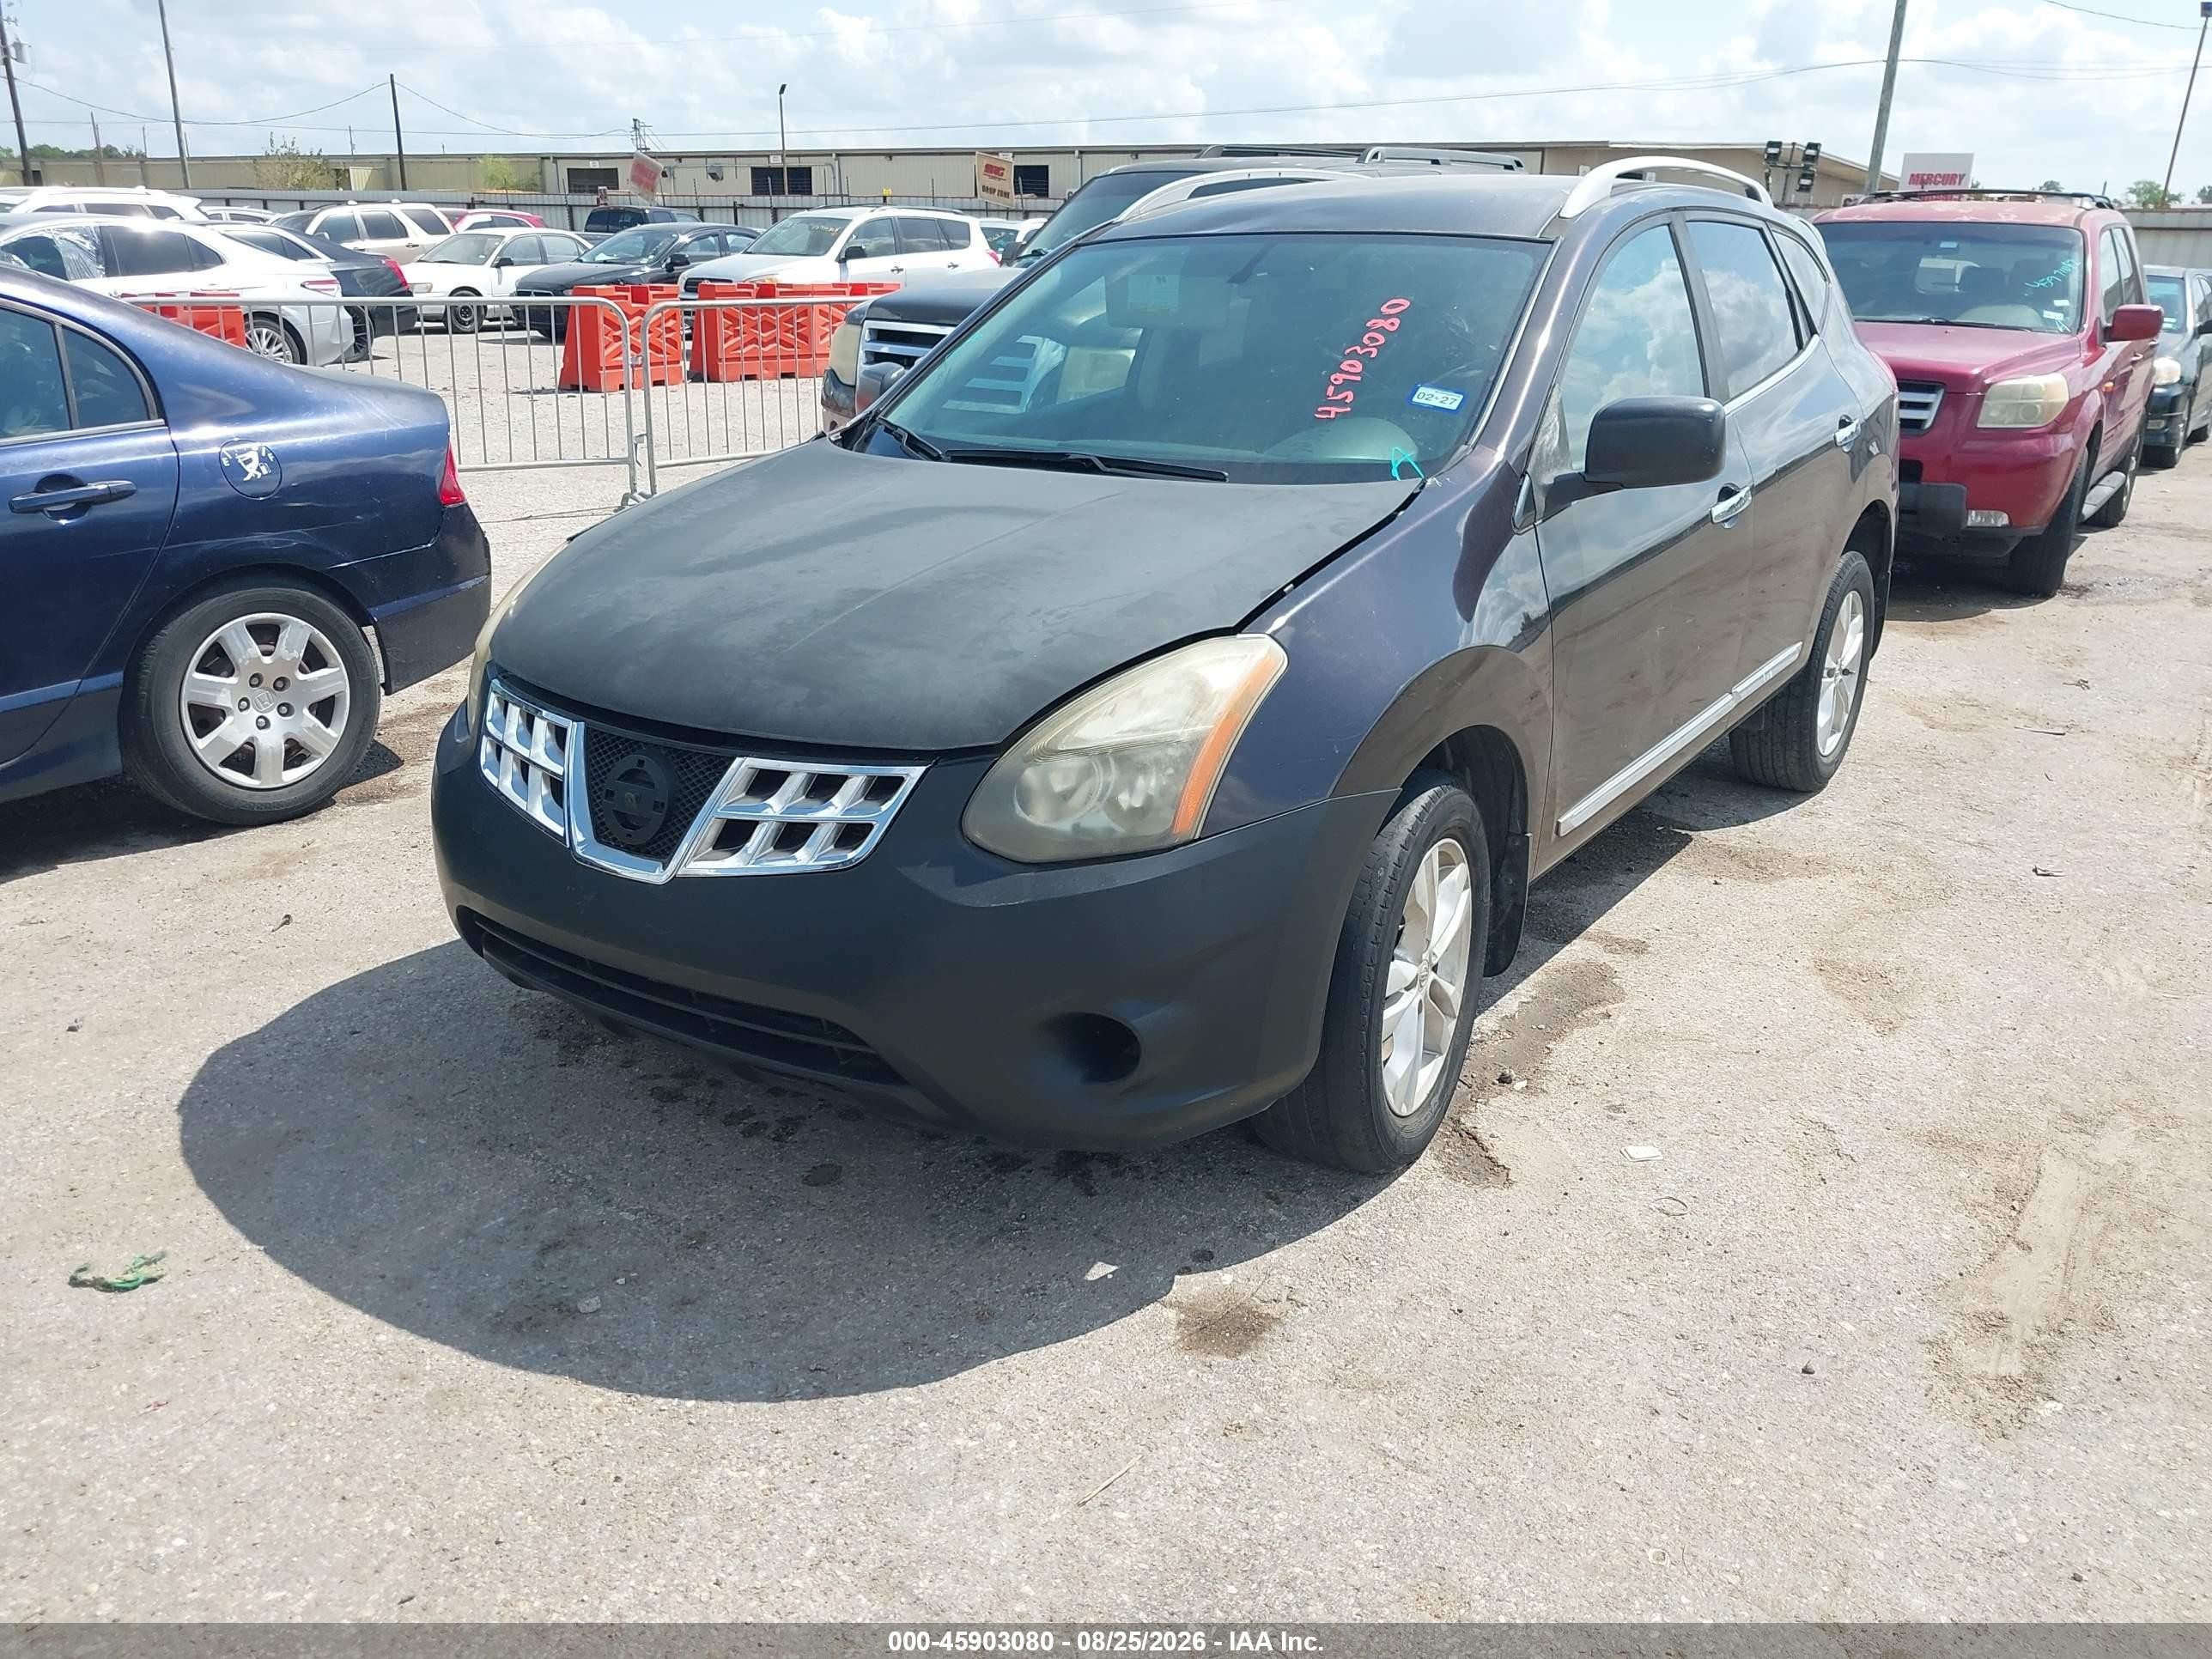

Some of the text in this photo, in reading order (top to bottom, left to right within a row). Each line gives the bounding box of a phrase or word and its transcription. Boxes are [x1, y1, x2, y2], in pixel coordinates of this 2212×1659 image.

[1908, 173, 1966, 186] MERCURY
[1314, 298, 1411, 419] 45903080
[222, 457, 230, 466] E
[267, 453, 274, 462] F
